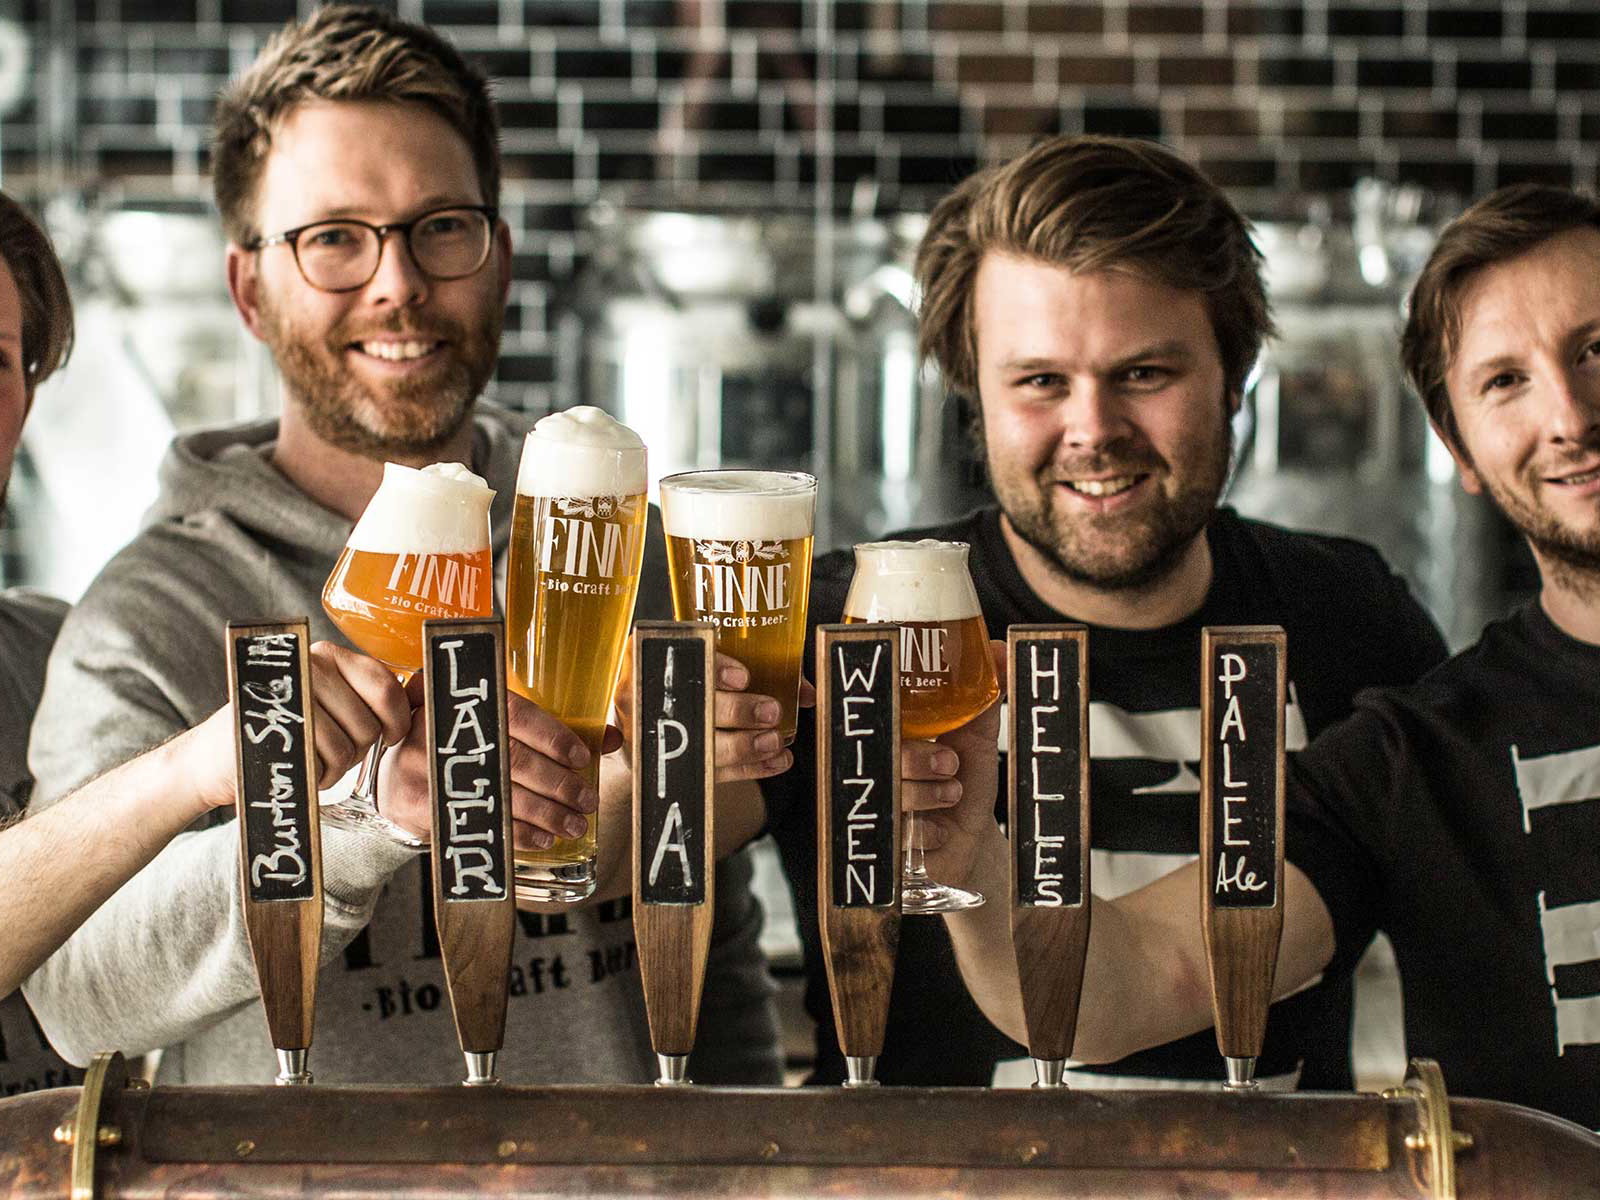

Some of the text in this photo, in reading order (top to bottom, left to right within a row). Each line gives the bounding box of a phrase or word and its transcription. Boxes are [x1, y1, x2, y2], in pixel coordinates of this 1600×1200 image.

[386, 548, 482, 612] FINNE
[573, 582, 611, 595] Craft
[693, 563, 791, 613] FINNE
[723, 616, 757, 627] Craft
[438, 640, 504, 895] LAGER
[648, 646, 693, 887] IPA
[838, 644, 881, 904] WEIZEN
[1031, 645, 1065, 907] HELLES
[1219, 654, 1250, 845] PALE
[251, 763, 307, 888] Burton
[1216, 852, 1267, 894] Ale
